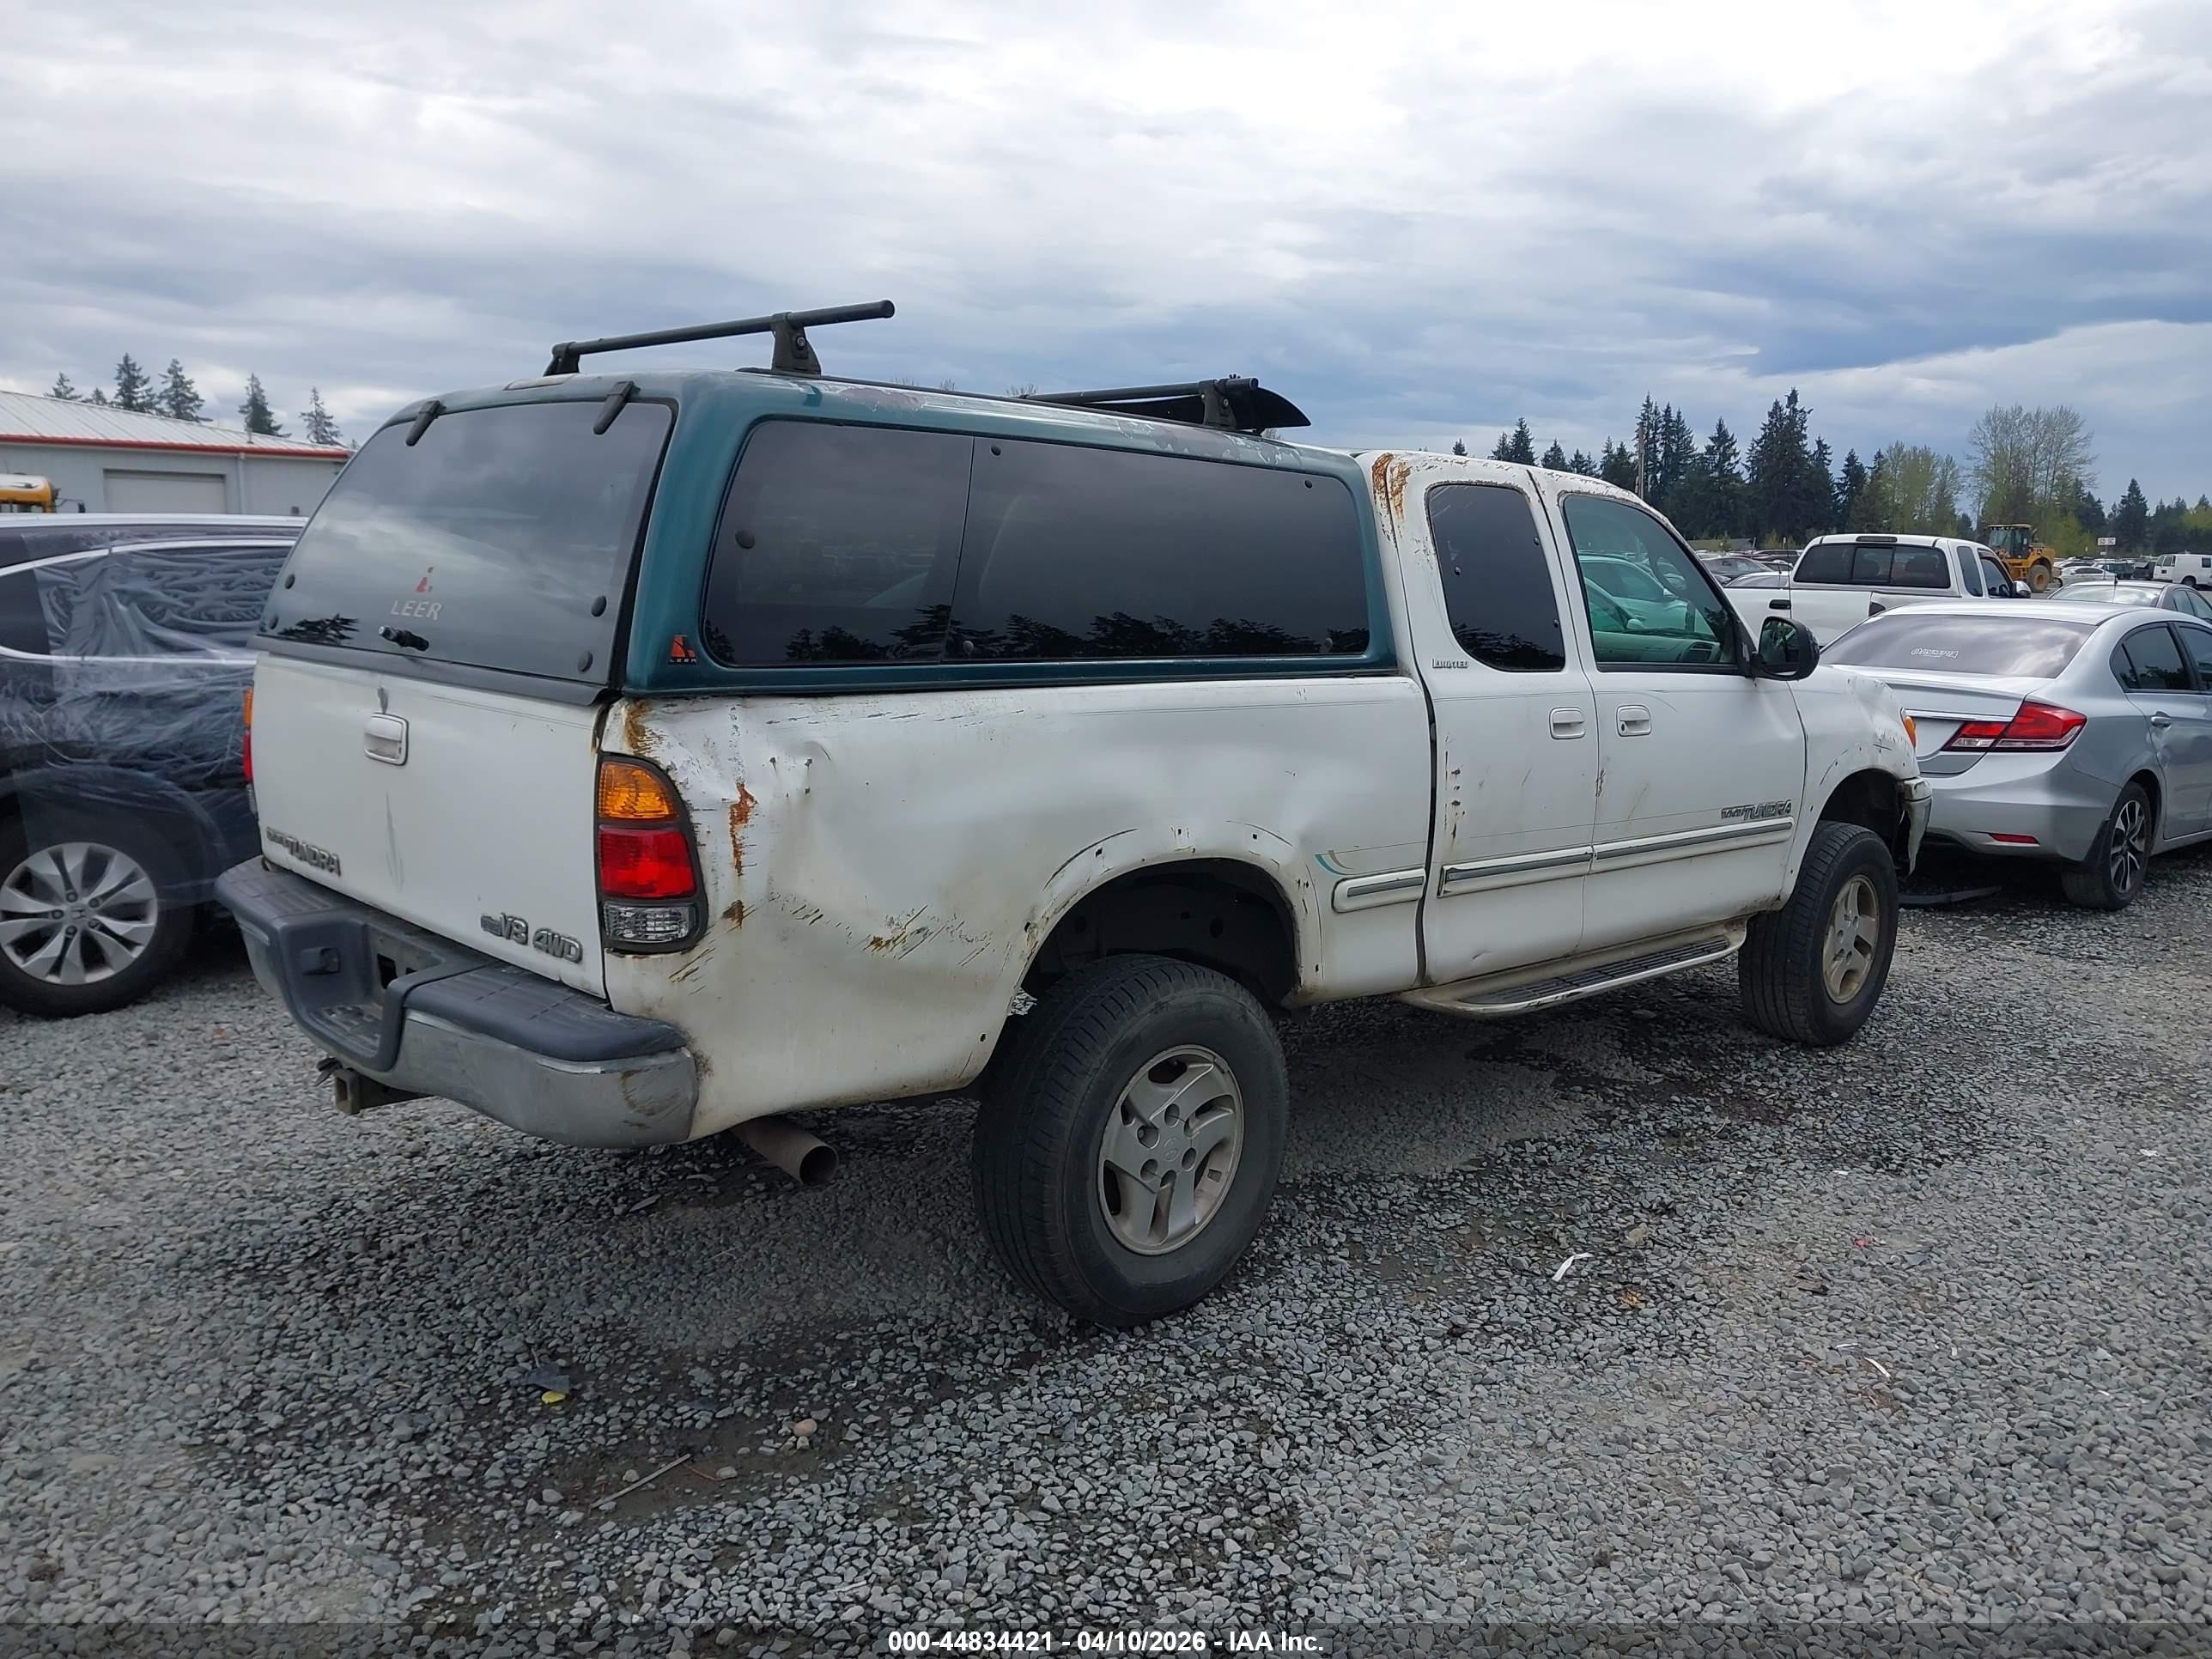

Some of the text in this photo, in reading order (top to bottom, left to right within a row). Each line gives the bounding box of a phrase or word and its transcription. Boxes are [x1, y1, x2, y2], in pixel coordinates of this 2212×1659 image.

[391, 600, 442, 620] LEER
[287, 836, 341, 876] TUNDRA
[532, 928, 583, 963] 4WD
